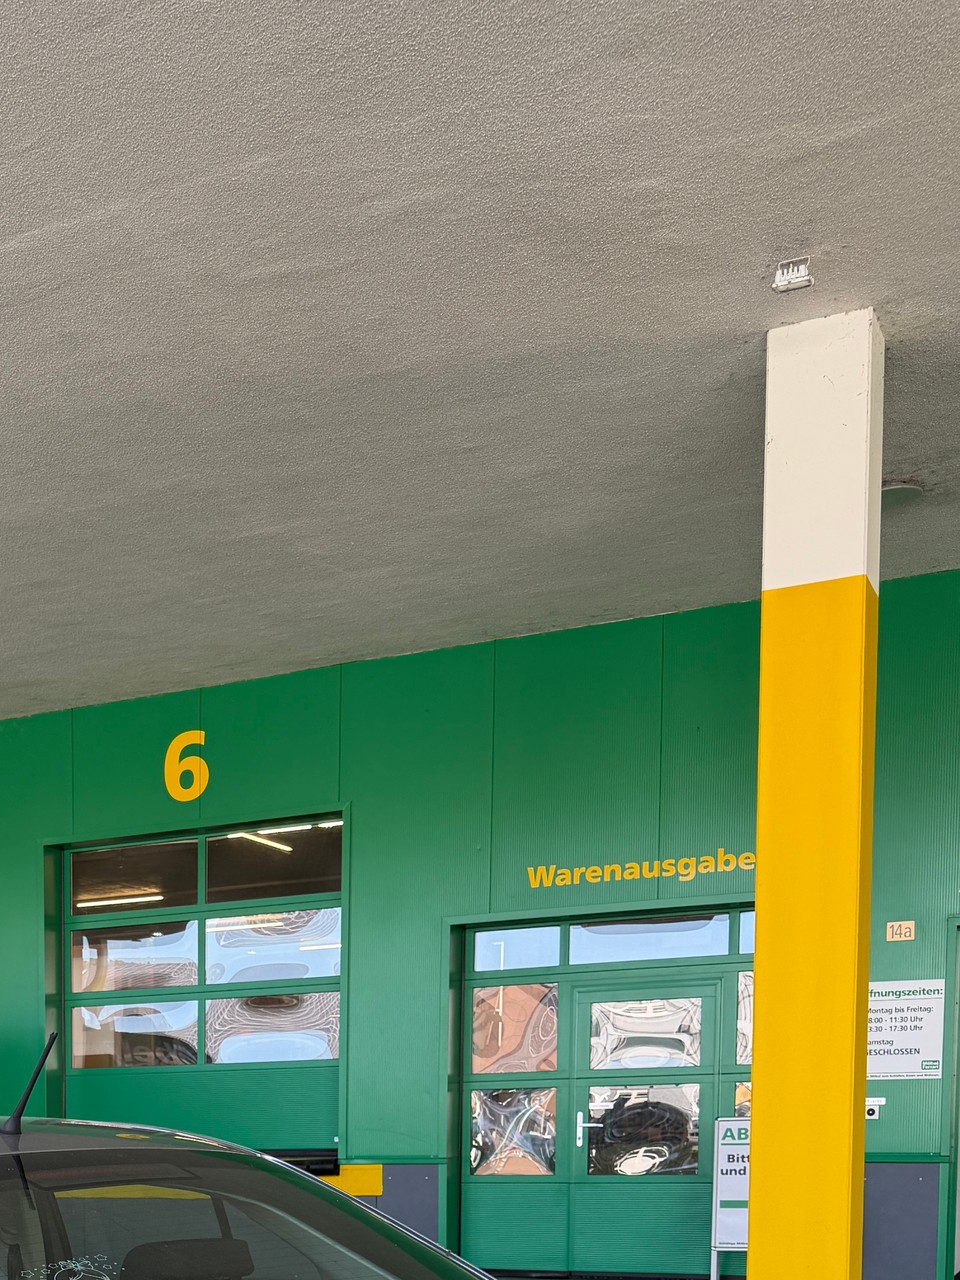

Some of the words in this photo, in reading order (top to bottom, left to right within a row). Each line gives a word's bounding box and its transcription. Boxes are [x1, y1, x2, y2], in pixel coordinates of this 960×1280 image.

[164, 730, 209, 802] 6
[527, 848, 755, 888] Warenausgabe
[889, 923, 912, 939] 14a
[869, 987, 943, 998] fnungszeiten:
[907, 1005, 934, 1013] Freitag:
[721, 1127, 749, 1140] AB
[727, 1153, 750, 1163] Bitt
[720, 1166, 747, 1175] und
